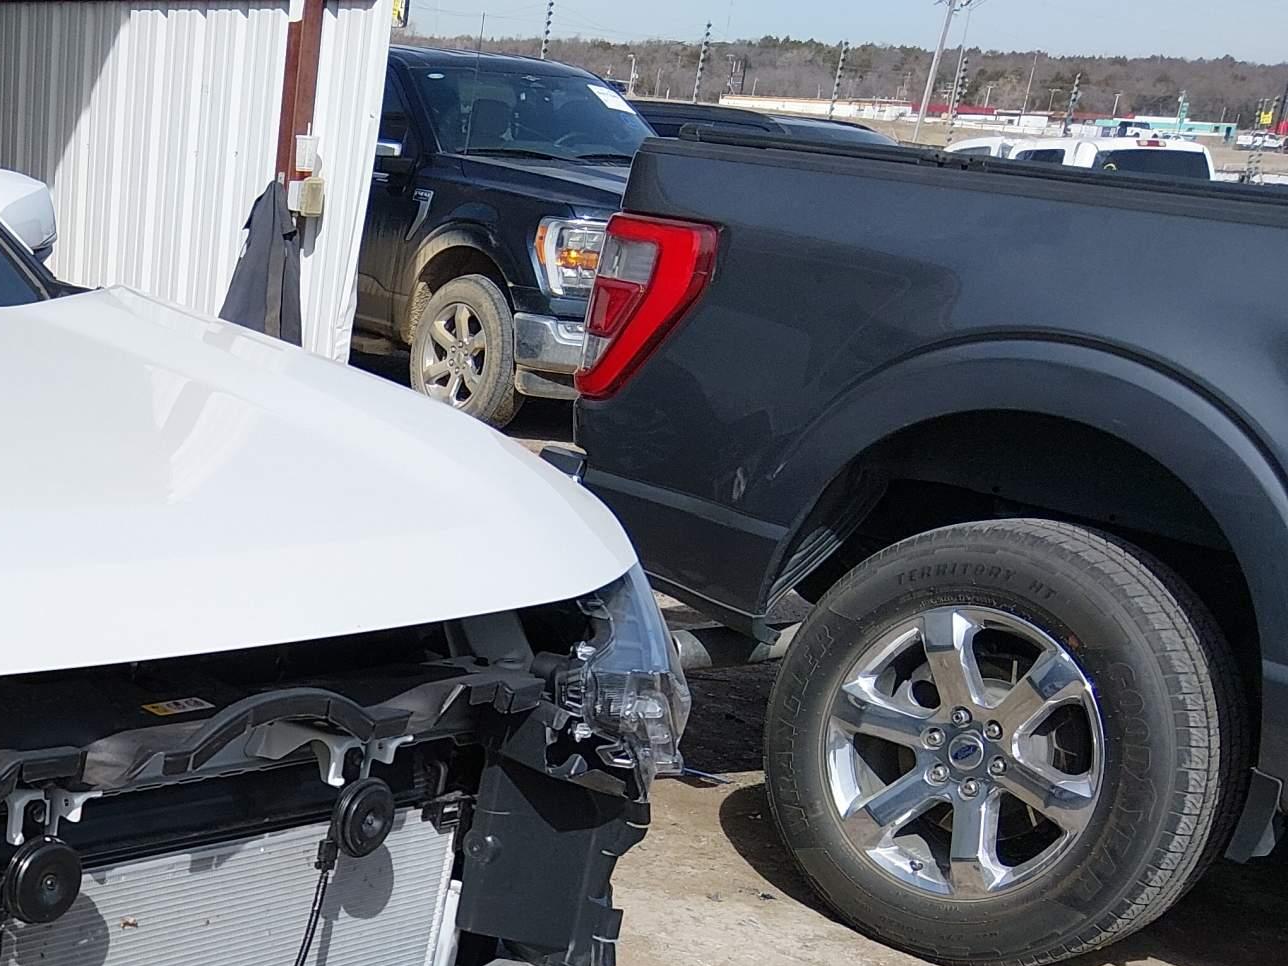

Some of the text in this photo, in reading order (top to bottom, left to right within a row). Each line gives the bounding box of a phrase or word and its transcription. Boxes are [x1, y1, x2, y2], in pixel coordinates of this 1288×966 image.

[896, 562, 1058, 600] TERRITORY HT
[1086, 662, 1158, 901] GOODYEAR
